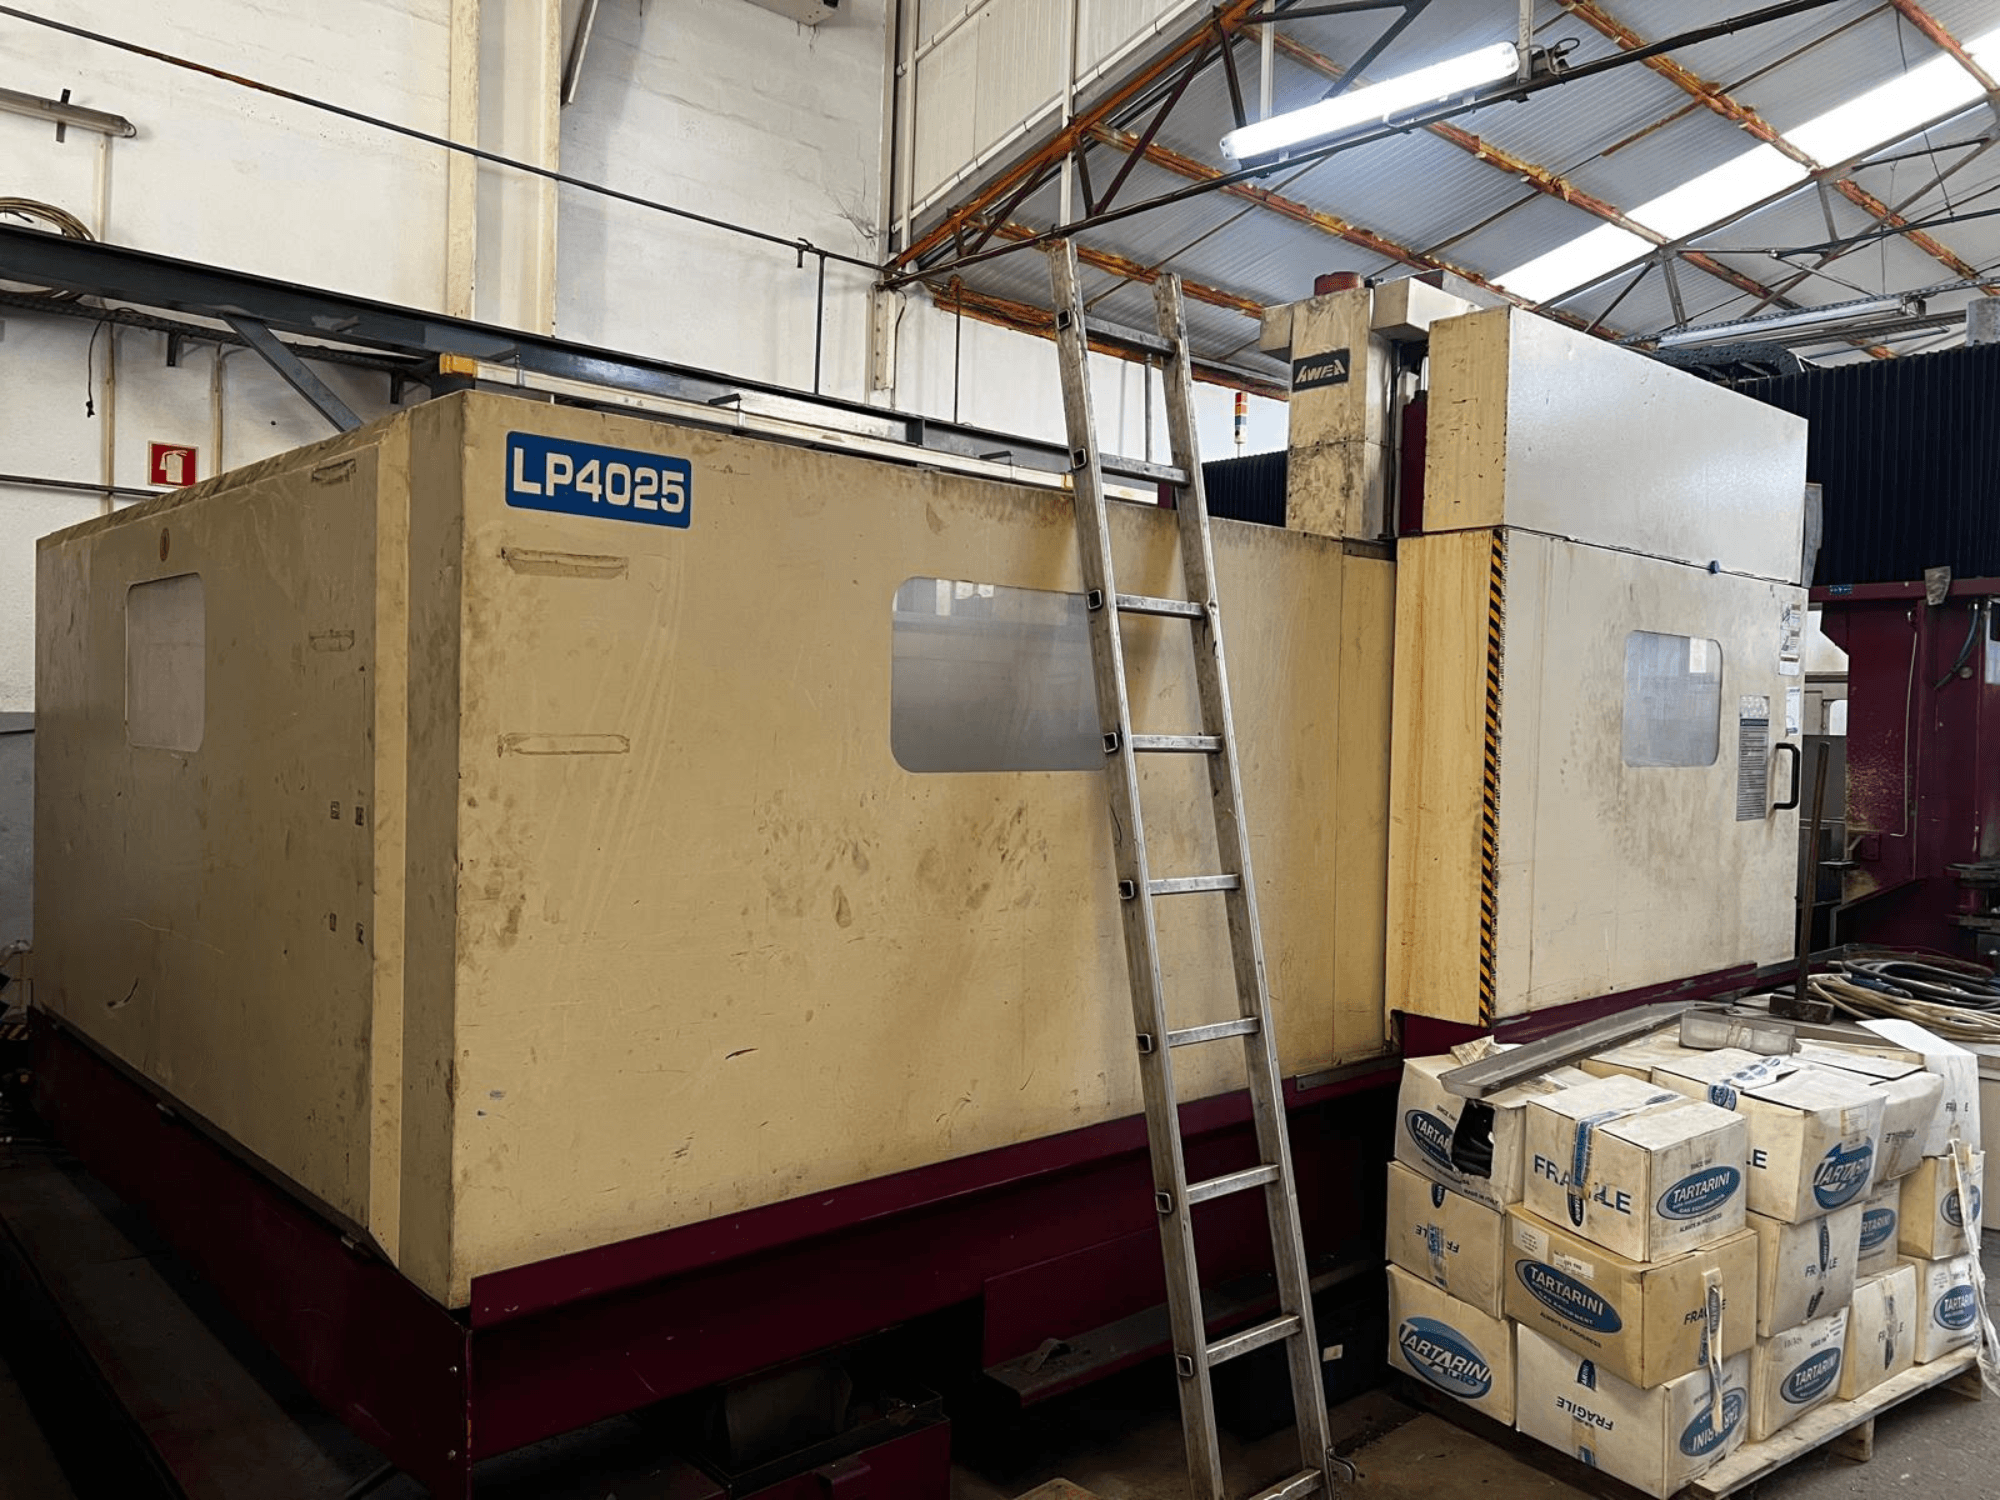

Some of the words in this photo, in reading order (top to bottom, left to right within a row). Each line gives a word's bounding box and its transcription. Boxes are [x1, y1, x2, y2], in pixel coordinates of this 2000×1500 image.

[1294, 359, 1346, 384] AWEA
[512, 446, 686, 513] LP4025
[1673, 1171, 1731, 1204] TARTARINI
[1530, 1266, 1604, 1316] TARTARINI
[1400, 1320, 1492, 1383] TARTARINI
[1555, 1395, 1614, 1431] FRAGILE
